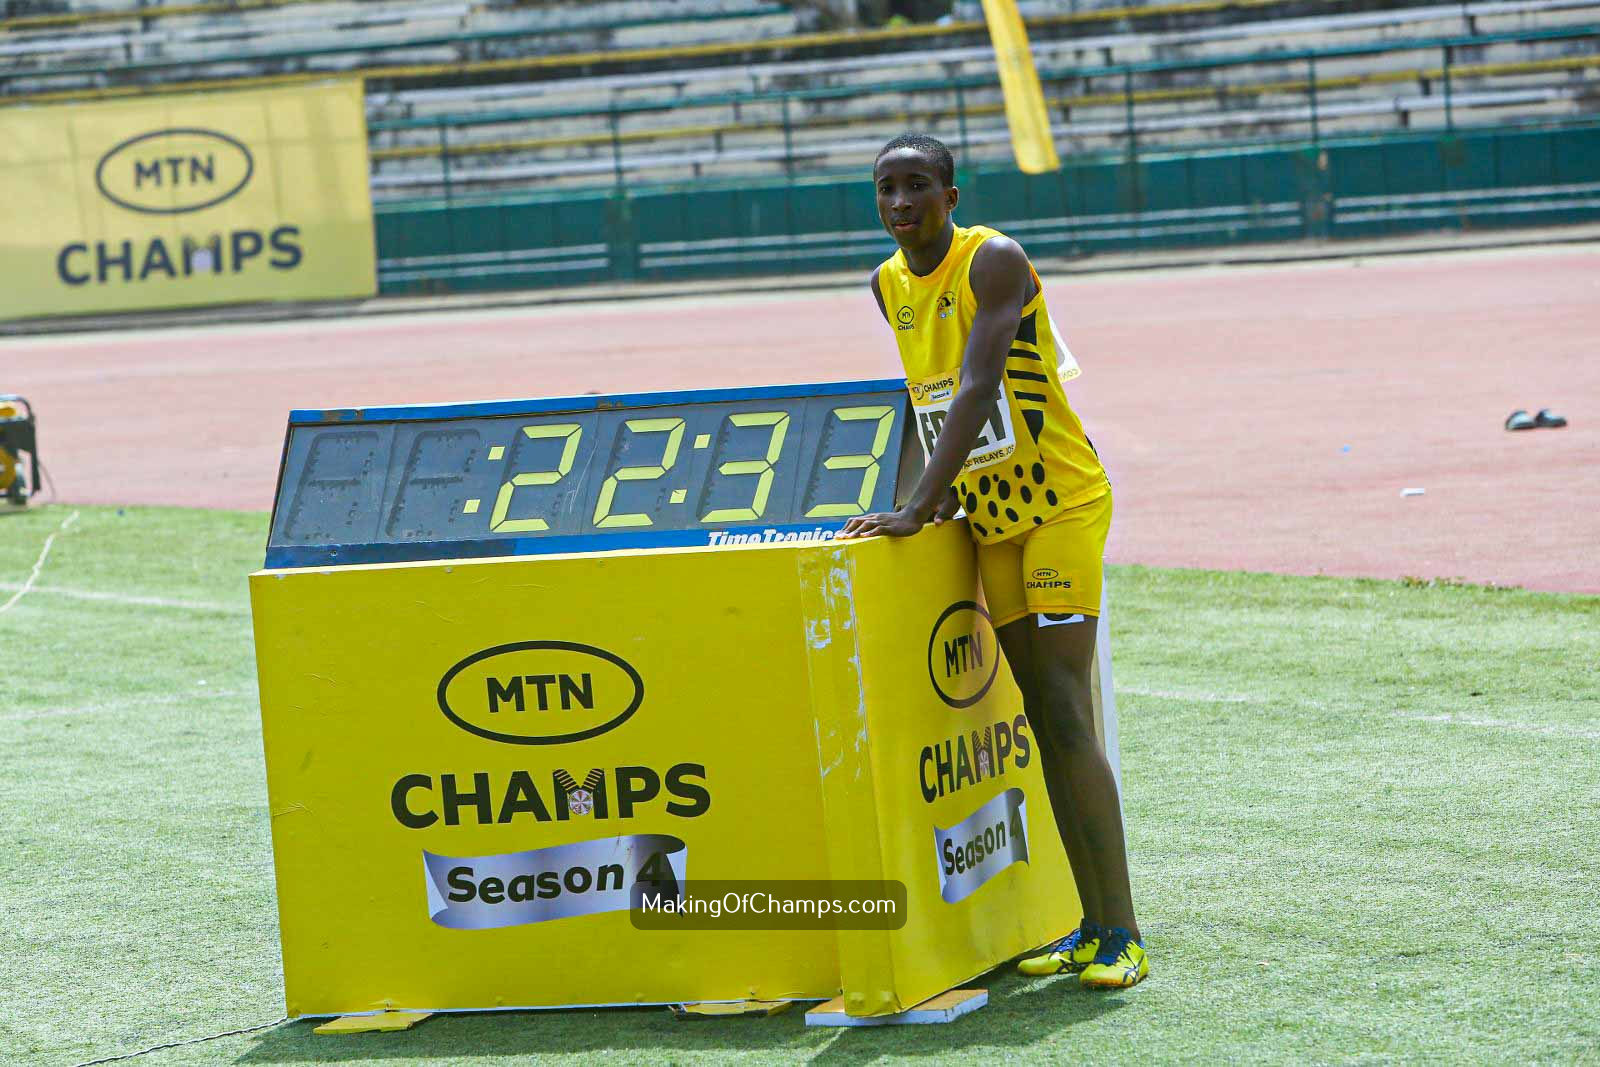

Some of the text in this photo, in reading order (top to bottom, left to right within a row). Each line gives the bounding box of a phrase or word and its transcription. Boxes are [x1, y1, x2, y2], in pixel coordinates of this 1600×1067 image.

[134, 154, 216, 188] MTN
[57, 226, 303, 286] CHAMPS
[923, 378, 954, 393] CHAMPS
[1026, 581, 1071, 589] CHAMPS
[943, 631, 984, 678] MTN
[485, 672, 595, 713] MTN
[919, 714, 1031, 804] CHAMPS
[390, 762, 712, 829] CHAMPS
[943, 820, 1006, 876] Season
[446, 850, 665, 904] Season 4
